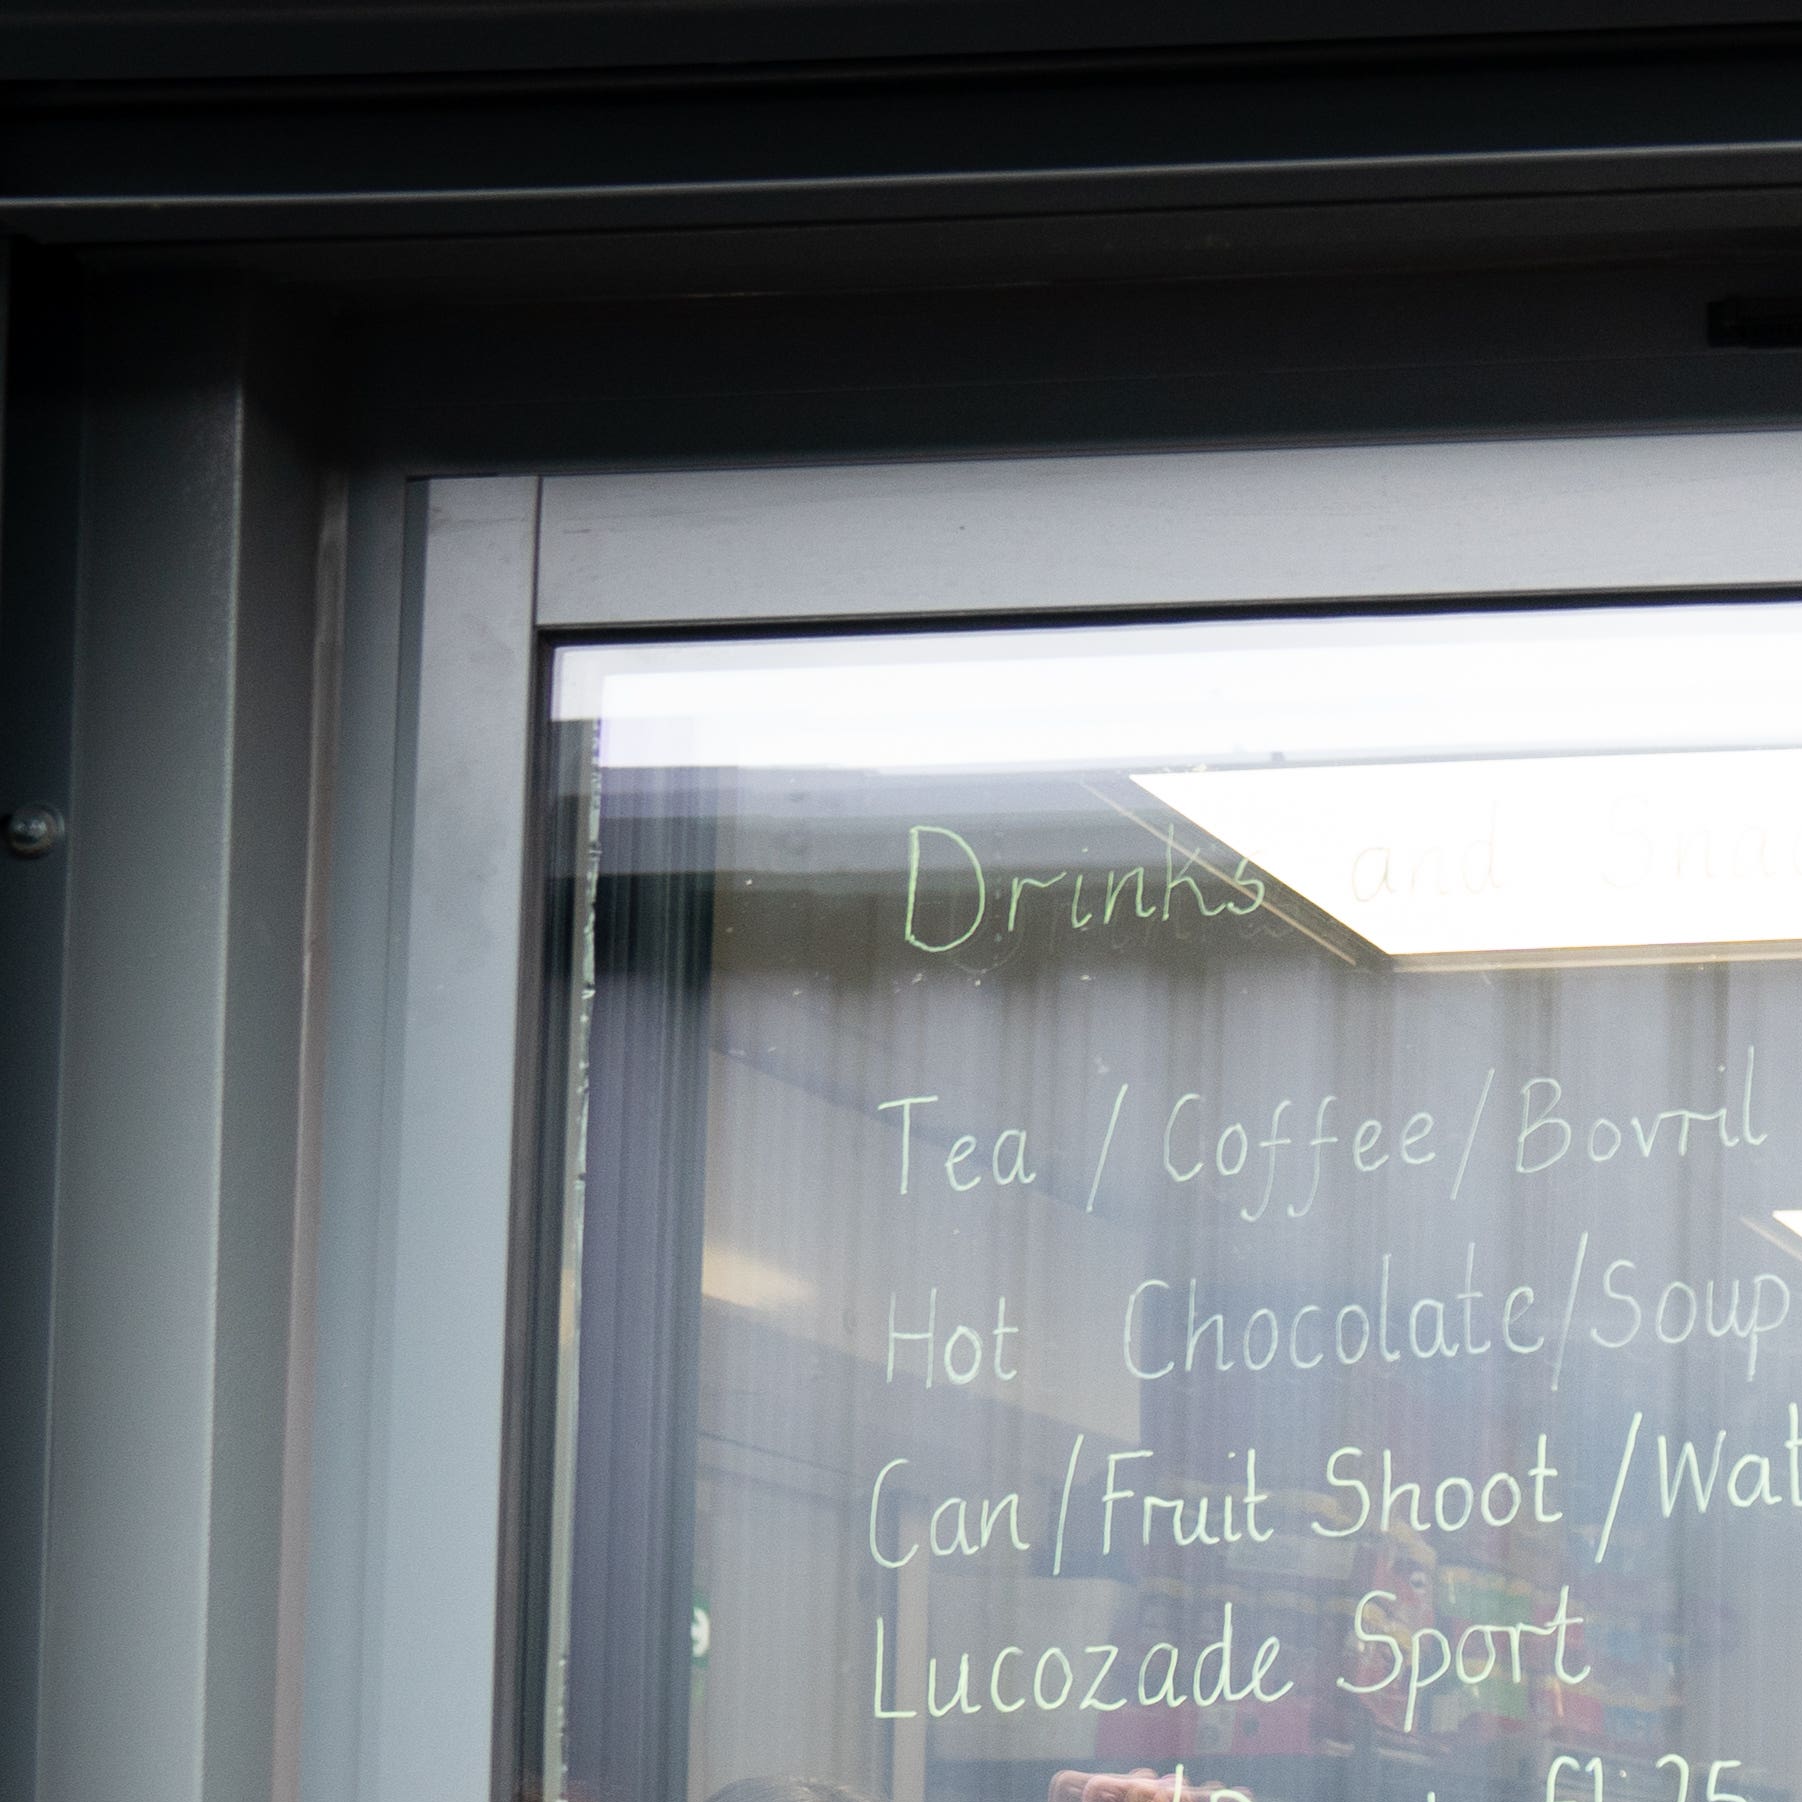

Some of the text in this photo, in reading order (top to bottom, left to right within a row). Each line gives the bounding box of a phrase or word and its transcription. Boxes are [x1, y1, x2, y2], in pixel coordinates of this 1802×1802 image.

[904, 824, 1267, 952] Drinks
[885, 1286, 1019, 1389] Hot
[1311, 1433, 1563, 1538] Shoot
[873, 1602, 1293, 1720] Lucozade
[1336, 1586, 1592, 1733] Sport
